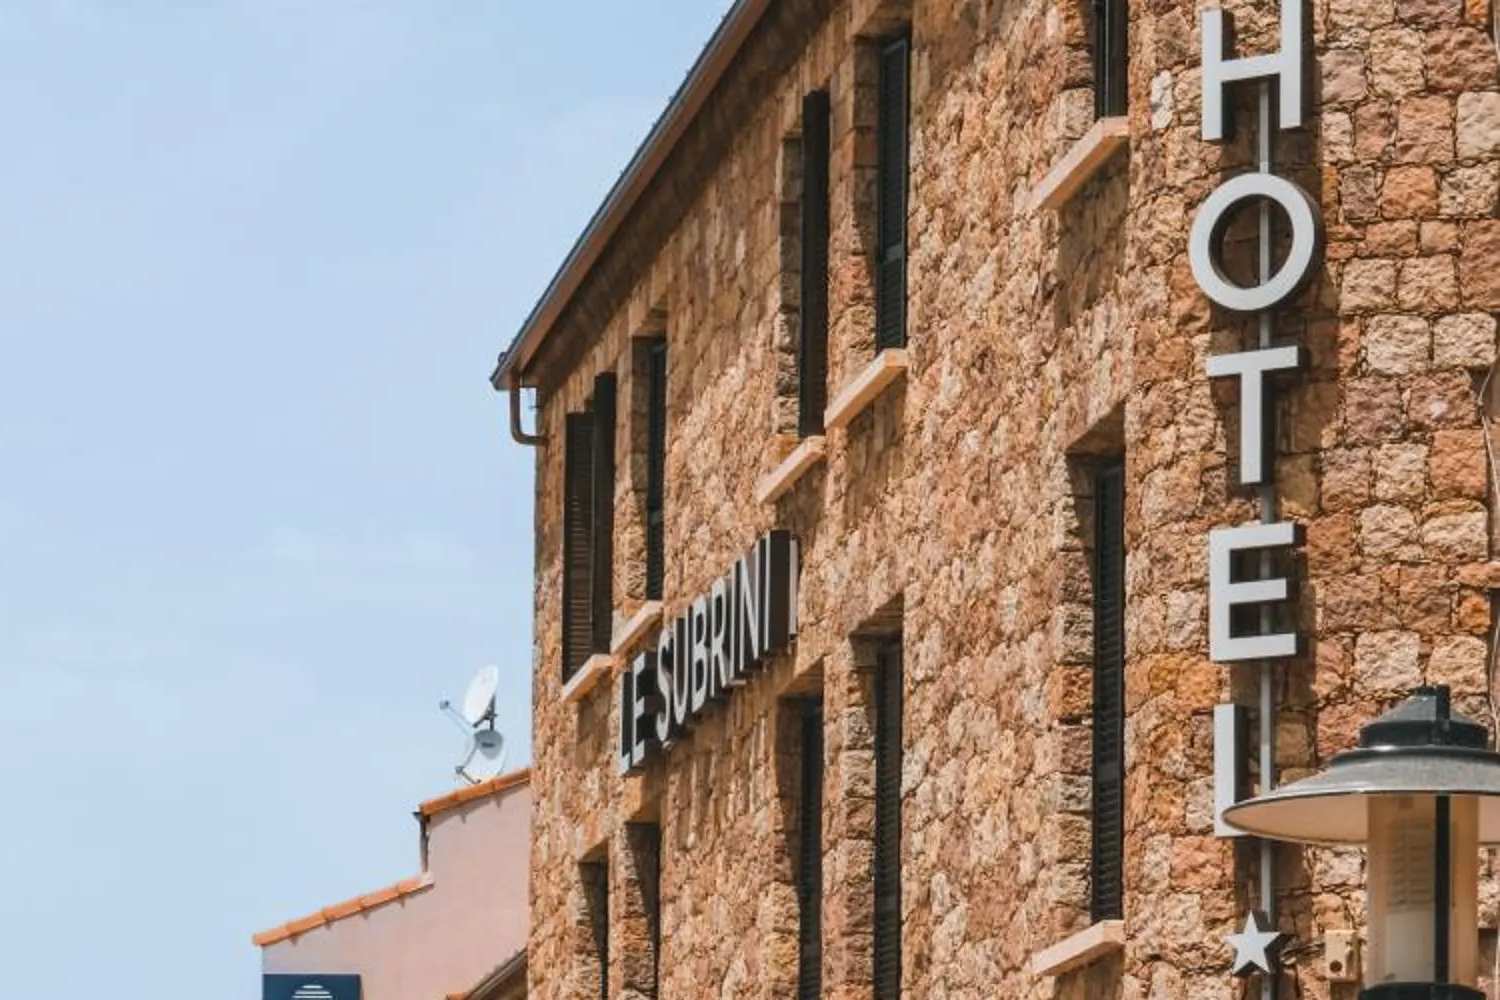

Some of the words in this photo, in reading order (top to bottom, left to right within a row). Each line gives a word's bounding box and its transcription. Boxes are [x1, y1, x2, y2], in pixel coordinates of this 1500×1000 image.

[617, 652, 646, 777] LE
[656, 531, 773, 743] SUBRINI
[1189, 0, 1315, 837] HOTEL
